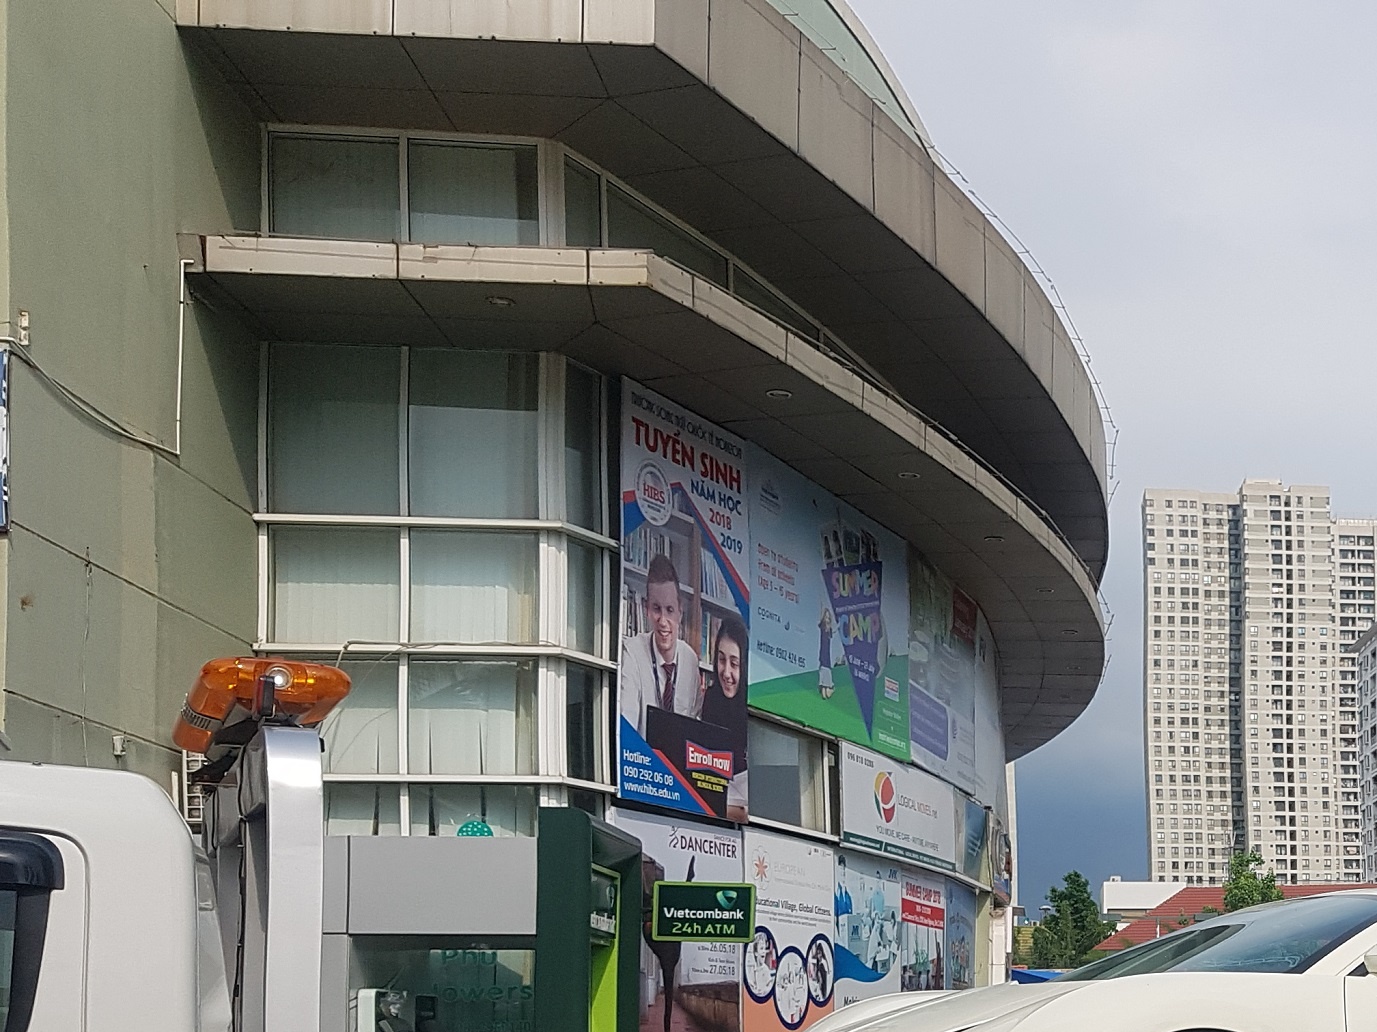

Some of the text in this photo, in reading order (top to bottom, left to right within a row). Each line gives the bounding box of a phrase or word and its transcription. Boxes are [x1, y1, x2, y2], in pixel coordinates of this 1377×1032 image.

[631, 415, 695, 472] TUYỂN
[700, 452, 742, 494] SINH
[643, 482, 665, 505] HIBS
[691, 478, 716, 504] NĂM
[719, 492, 742, 516] HỌC
[709, 507, 732, 530] 2018
[721, 532, 742, 554] 2019
[831, 569, 879, 600] SUMMER
[839, 612, 880, 646] CAMP
[623, 749, 652, 766] Hotline:
[688, 746, 730, 772] Enroll now
[623, 766, 674, 786] 090 292 06 08
[623, 781, 681, 802] www.hibs.edu.vn
[680, 835, 738, 859] DANCENTER
[663, 906, 744, 920] Vietcombank
[672, 922, 736, 935] 24h ATM
[709, 942, 736, 955] 26.05.18
[709, 964, 736, 977] 27.05.18
